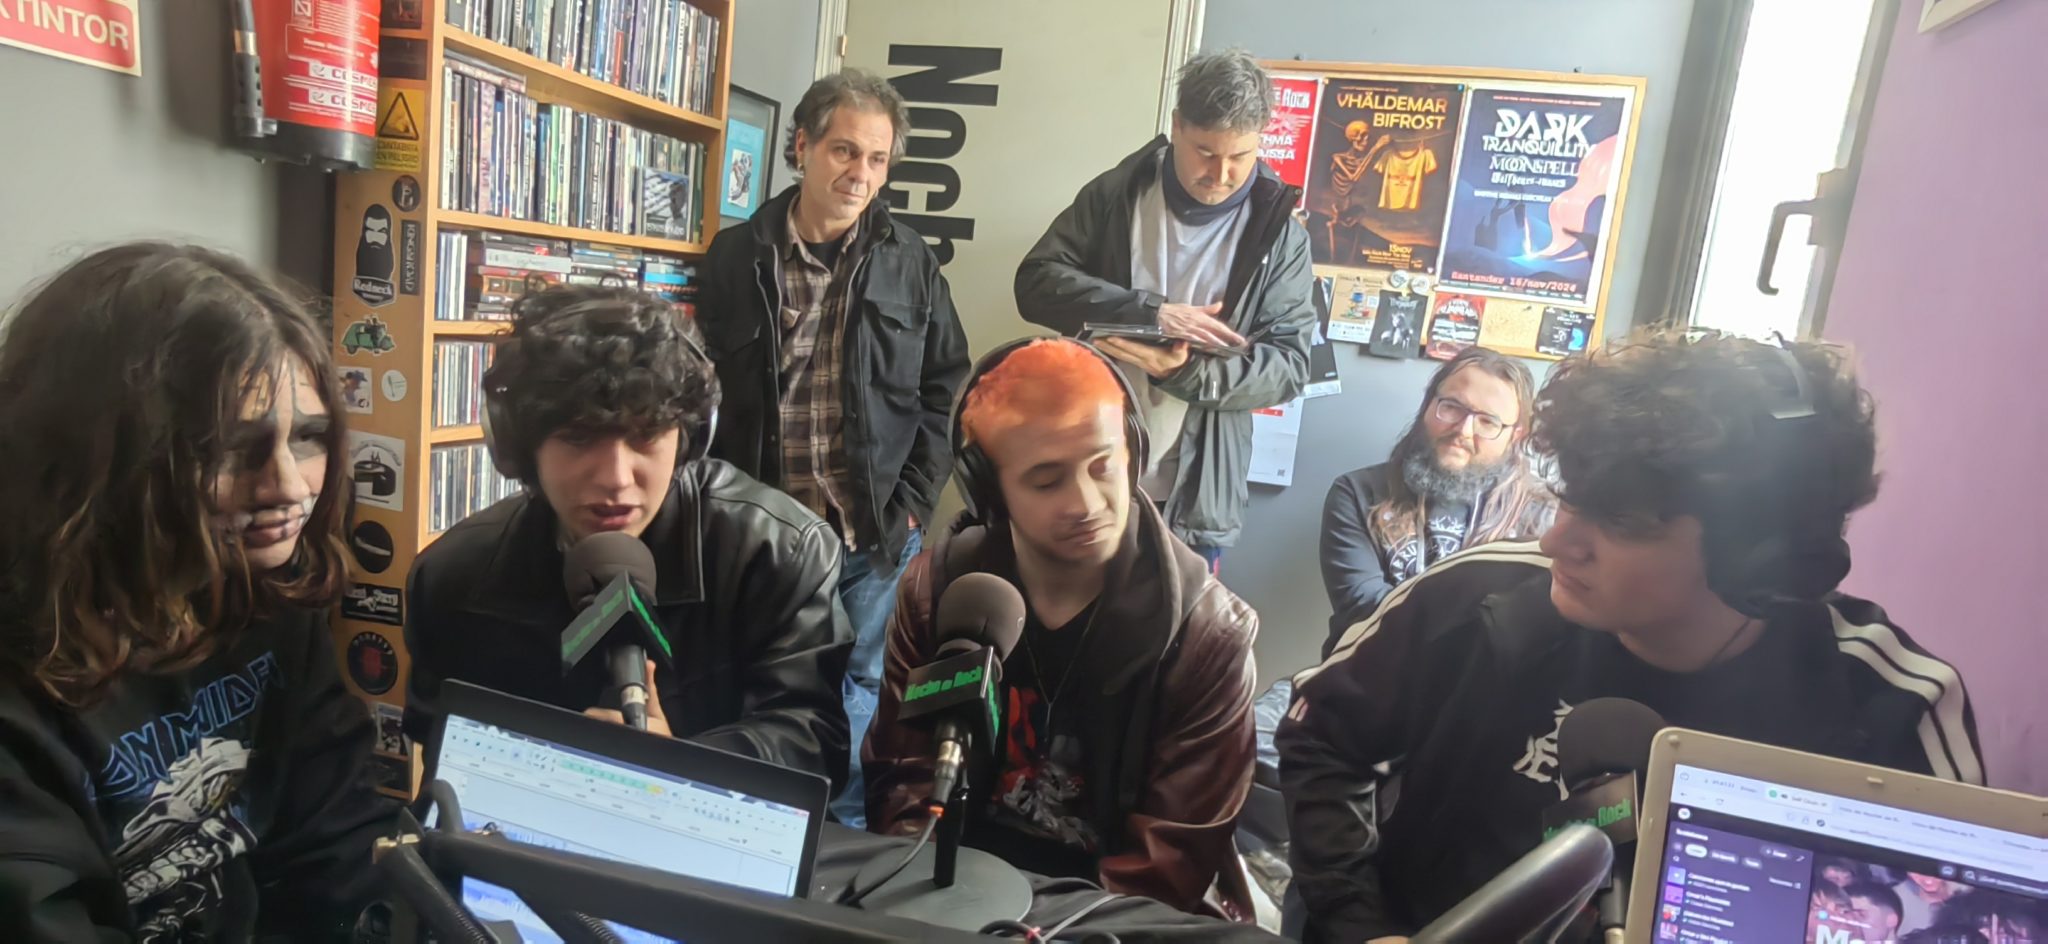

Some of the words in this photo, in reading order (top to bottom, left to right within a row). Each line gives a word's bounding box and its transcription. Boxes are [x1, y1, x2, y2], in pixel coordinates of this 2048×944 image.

[1336, 91, 1448, 113] VHÄLDEMAR
[1372, 112, 1446, 129] BIFROST
[1494, 109, 1594, 145] DARK
